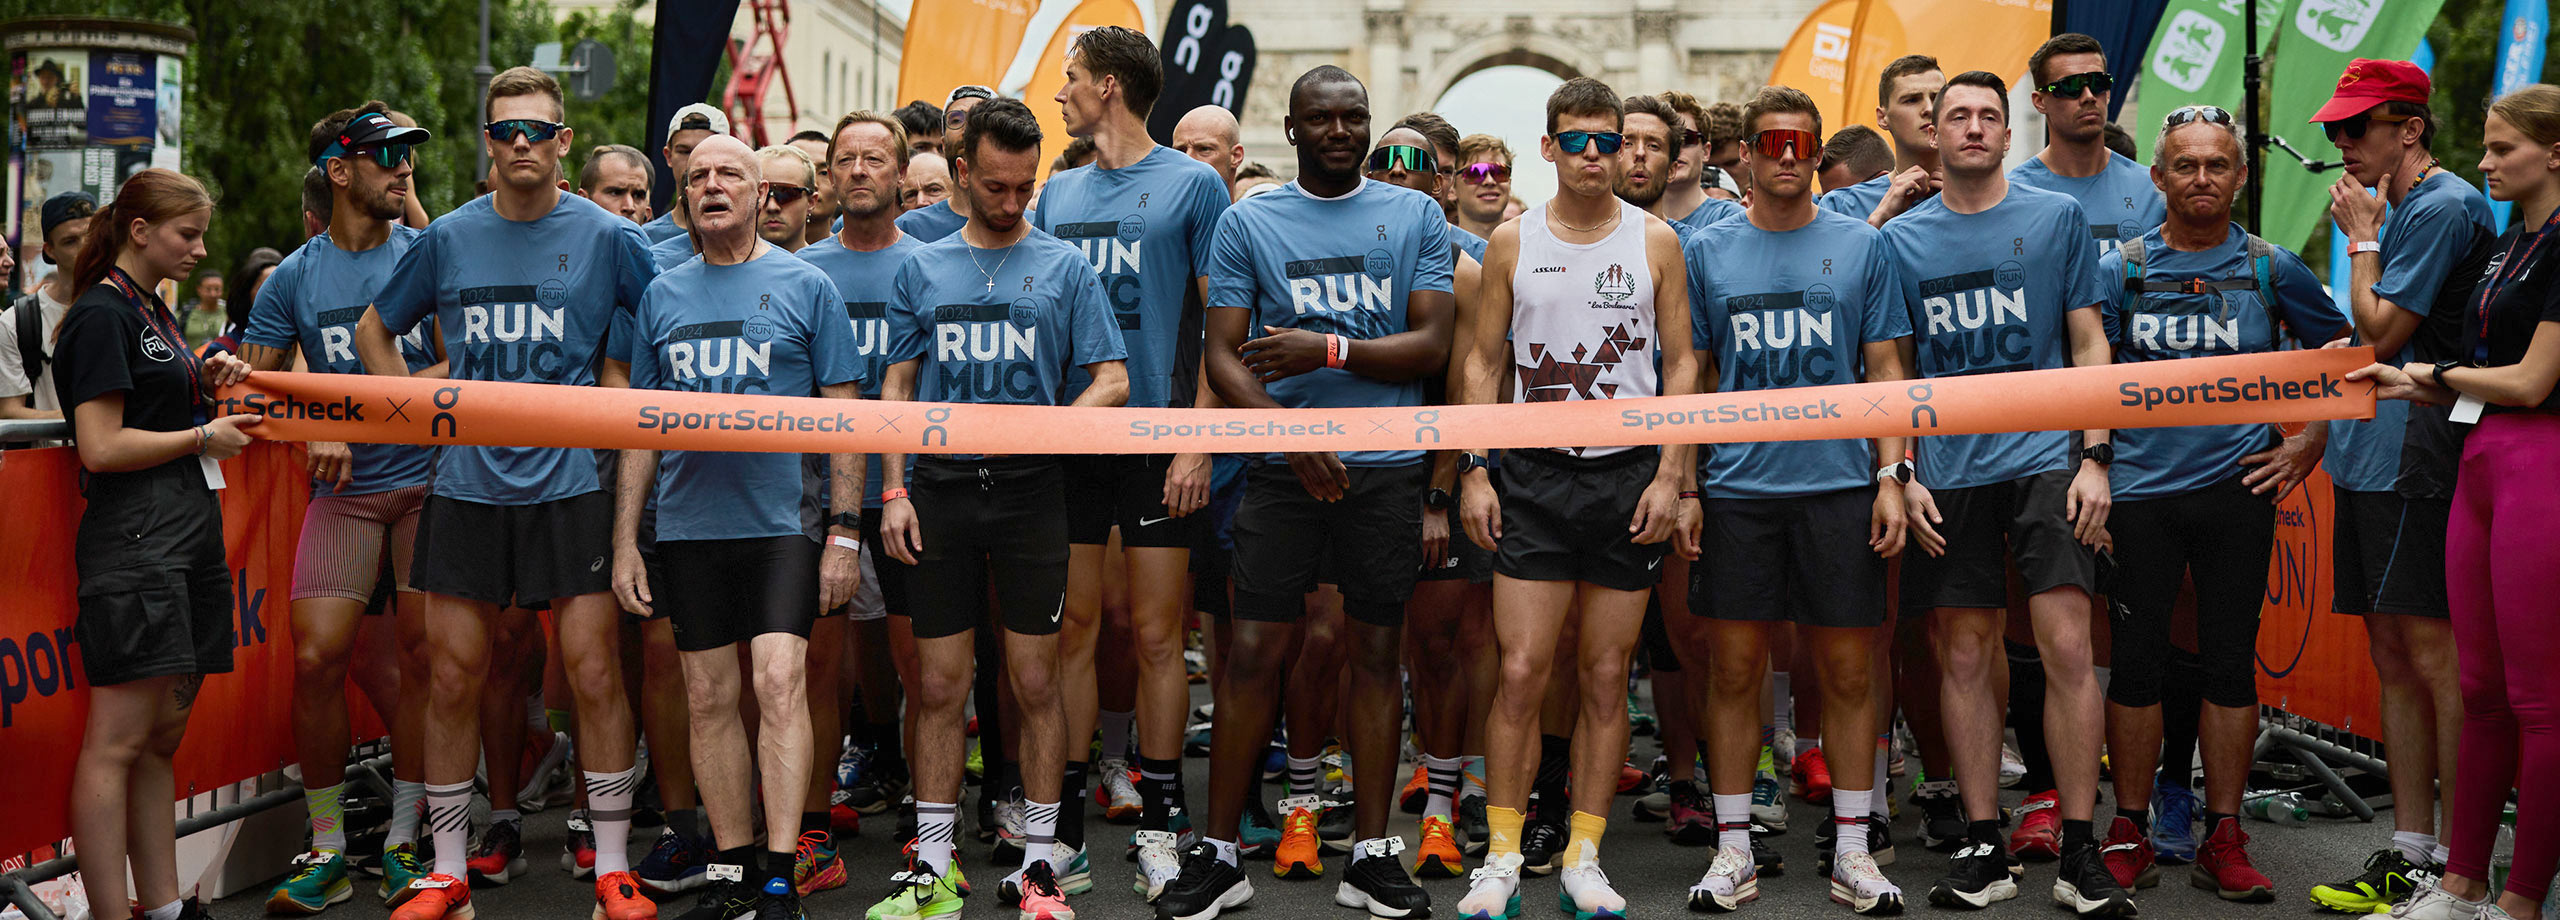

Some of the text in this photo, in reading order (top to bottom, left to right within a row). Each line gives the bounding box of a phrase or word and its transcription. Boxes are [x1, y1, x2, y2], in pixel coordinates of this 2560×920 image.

[1061, 238, 1141, 274] UN
[1288, 261, 1325, 277] 2024
[462, 288, 495, 304] 2024
[542, 292, 565, 300] RUN
[1290, 274, 1392, 314] RUN
[1729, 296, 1765, 312] 2024
[1921, 279, 1955, 297] 2024
[320, 309, 355, 325] 2024
[464, 304, 565, 344] RUN
[936, 306, 973, 321] 2024
[1014, 309, 1037, 319] RUN
[1923, 286, 2028, 336] RUN
[2214, 303, 2237, 312] RN
[671, 325, 703, 341] 2024
[748, 326, 771, 336] RUN
[936, 321, 1036, 362] RUN
[1730, 308, 1833, 352] RUN
[2132, 314, 2239, 351] RUN
[464, 342, 565, 381] MUC
[668, 337, 771, 381] RUN
[1930, 324, 2032, 373] MUC
[939, 361, 1038, 400] MUC
[1735, 347, 1835, 389] MUC
[215, 393, 364, 422] rtScheck
[637, 406, 855, 435] SportScheck
[1129, 420, 1346, 440] SportScheck
[1621, 399, 1842, 430] SportScheck
[2119, 372, 2343, 411] SportScheck
